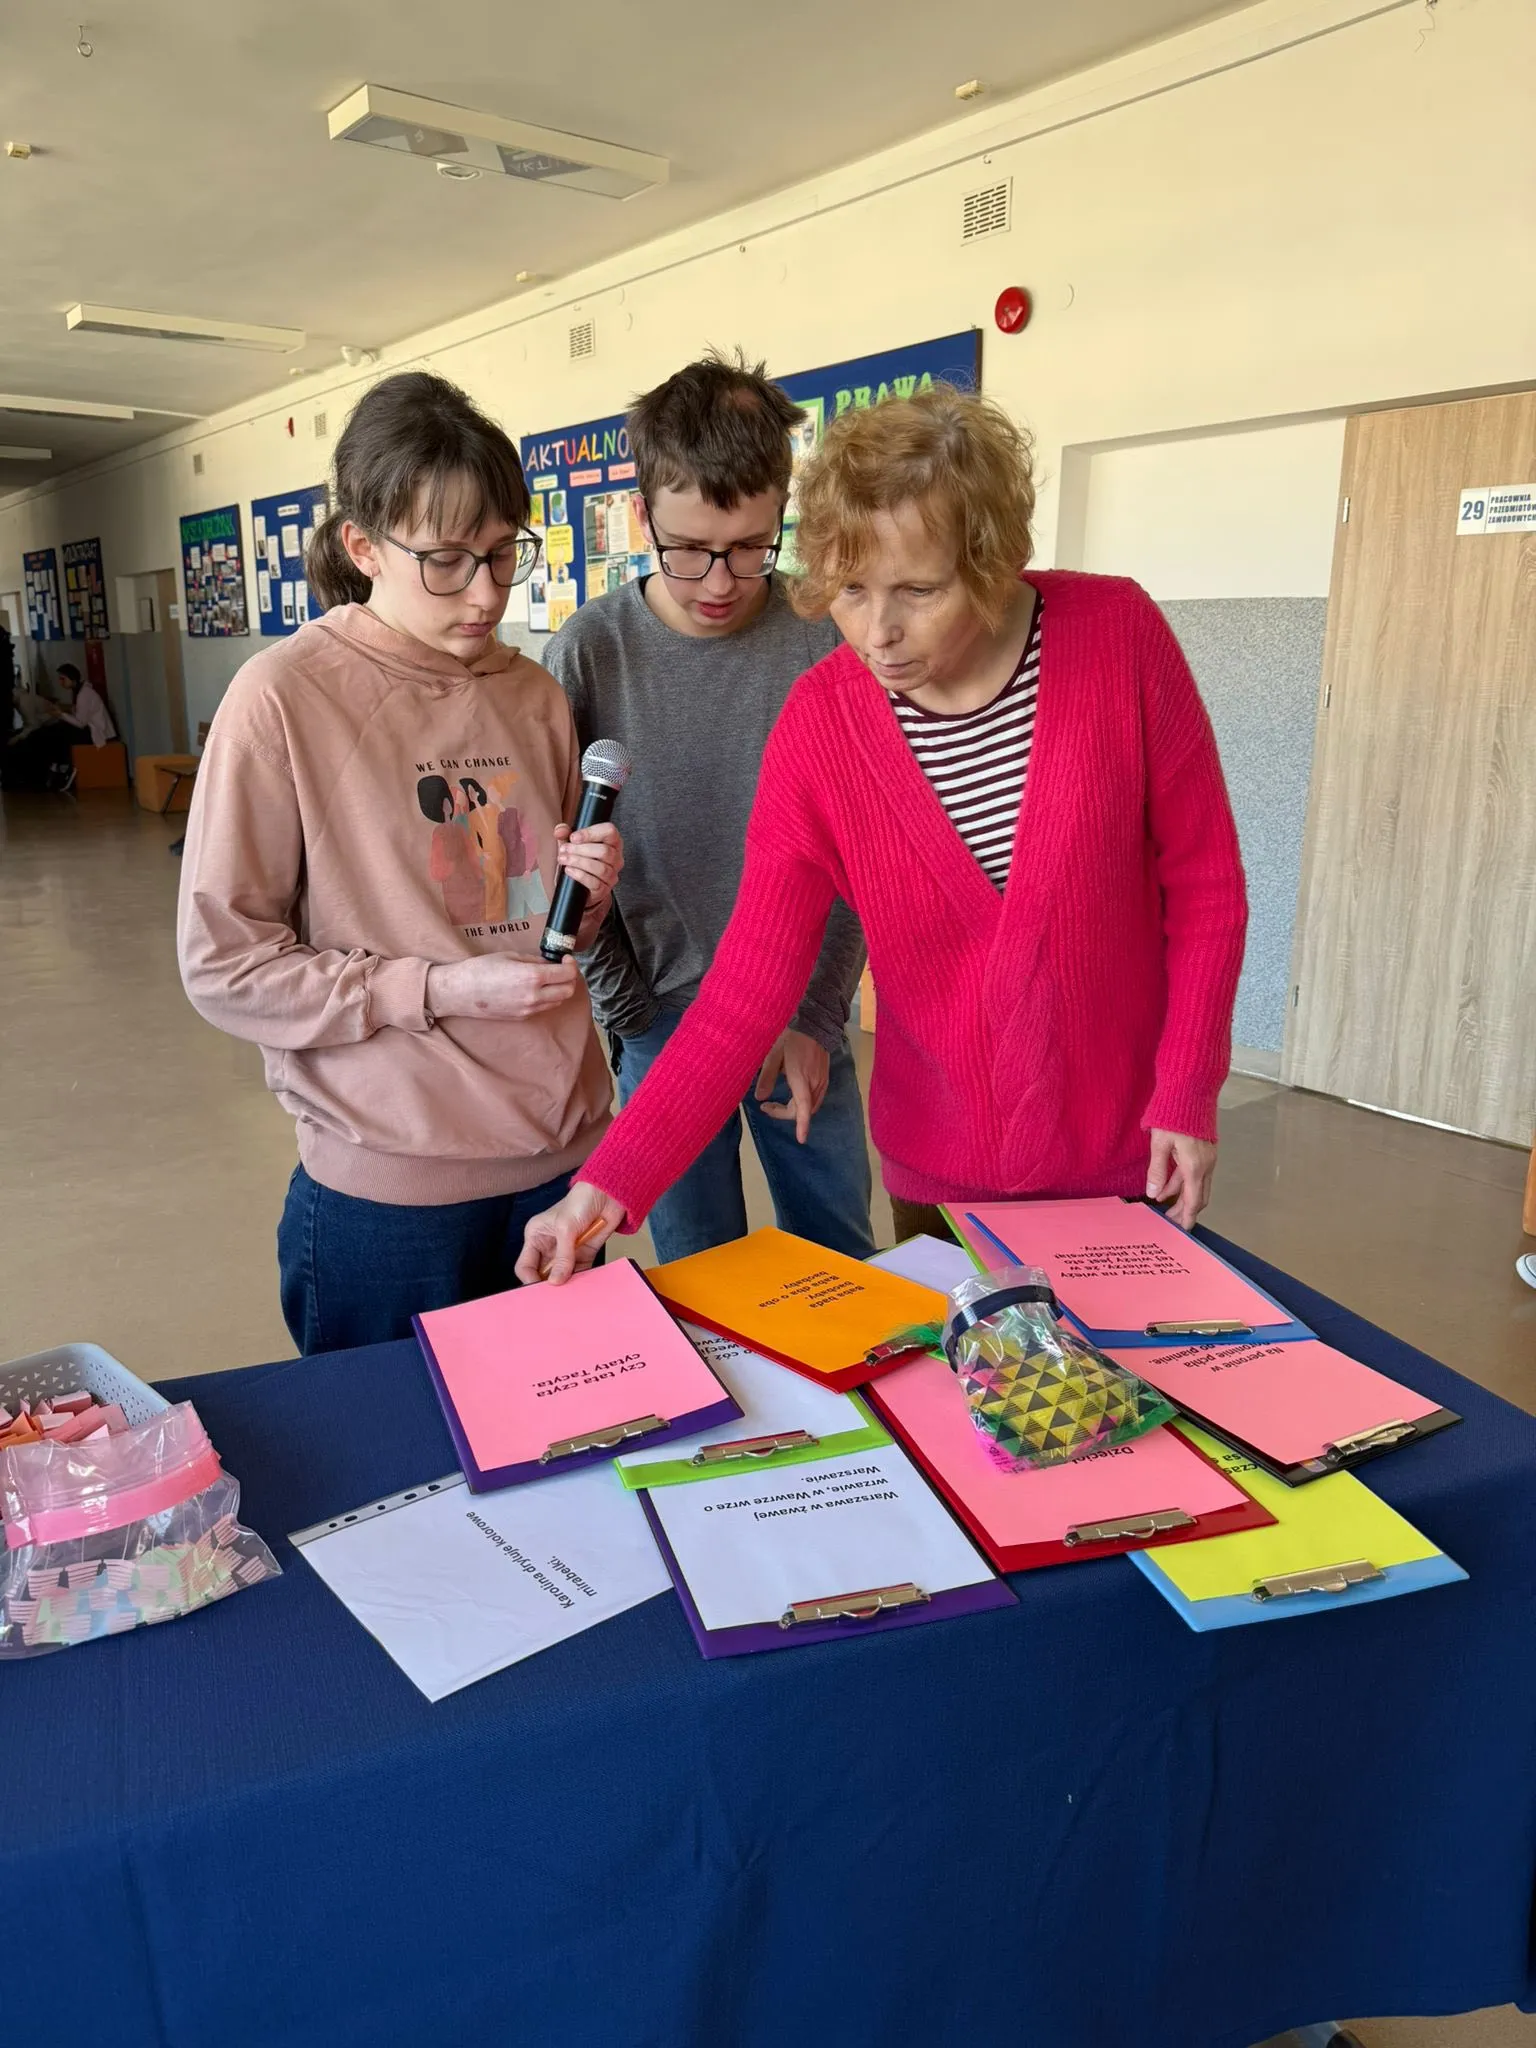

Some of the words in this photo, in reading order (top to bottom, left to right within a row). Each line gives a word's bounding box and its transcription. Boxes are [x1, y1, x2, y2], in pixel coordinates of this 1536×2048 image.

[835, 371, 935, 418] PRAWA
[525, 427, 630, 472] AKTUALNO
[1490, 494, 1531, 504] PRACOWNIA
[1461, 500, 1485, 521] 29
[416, 761, 436, 773] WE
[440, 758, 460, 769] CAN
[465, 756, 512, 769] CHANGE
[464, 926, 484, 938] THE
[489, 921, 530, 934] WORLD
[1148, 1346, 1199, 1366] pianinie.
[1266, 1346, 1284, 1355] Na
[594, 1354, 640, 1371] cytaty
[620, 1361, 646, 1373] Czy
[1222, 1351, 1265, 1368] peronie
[584, 1371, 615, 1384] tata
[1210, 1365, 1223, 1373] w
[532, 1369, 590, 1388] Tacyta.
[536, 1382, 578, 1398] czyta
[800, 1465, 880, 1484] Warszawie.
[812, 1488, 824, 1496] w
[826, 1478, 889, 1493] wrzawie,
[716, 1500, 751, 1510] wrze
[753, 1491, 811, 1504] Wawrze
[825, 1491, 899, 1508] Warszawa
[753, 1505, 807, 1521] żwawej
[810, 1503, 823, 1511] w
[466, 1511, 506, 1547] kolorowe
[503, 1545, 536, 1573] dryluje
[547, 1555, 598, 1597] mirabelki.
[533, 1572, 575, 1609] Karolina
